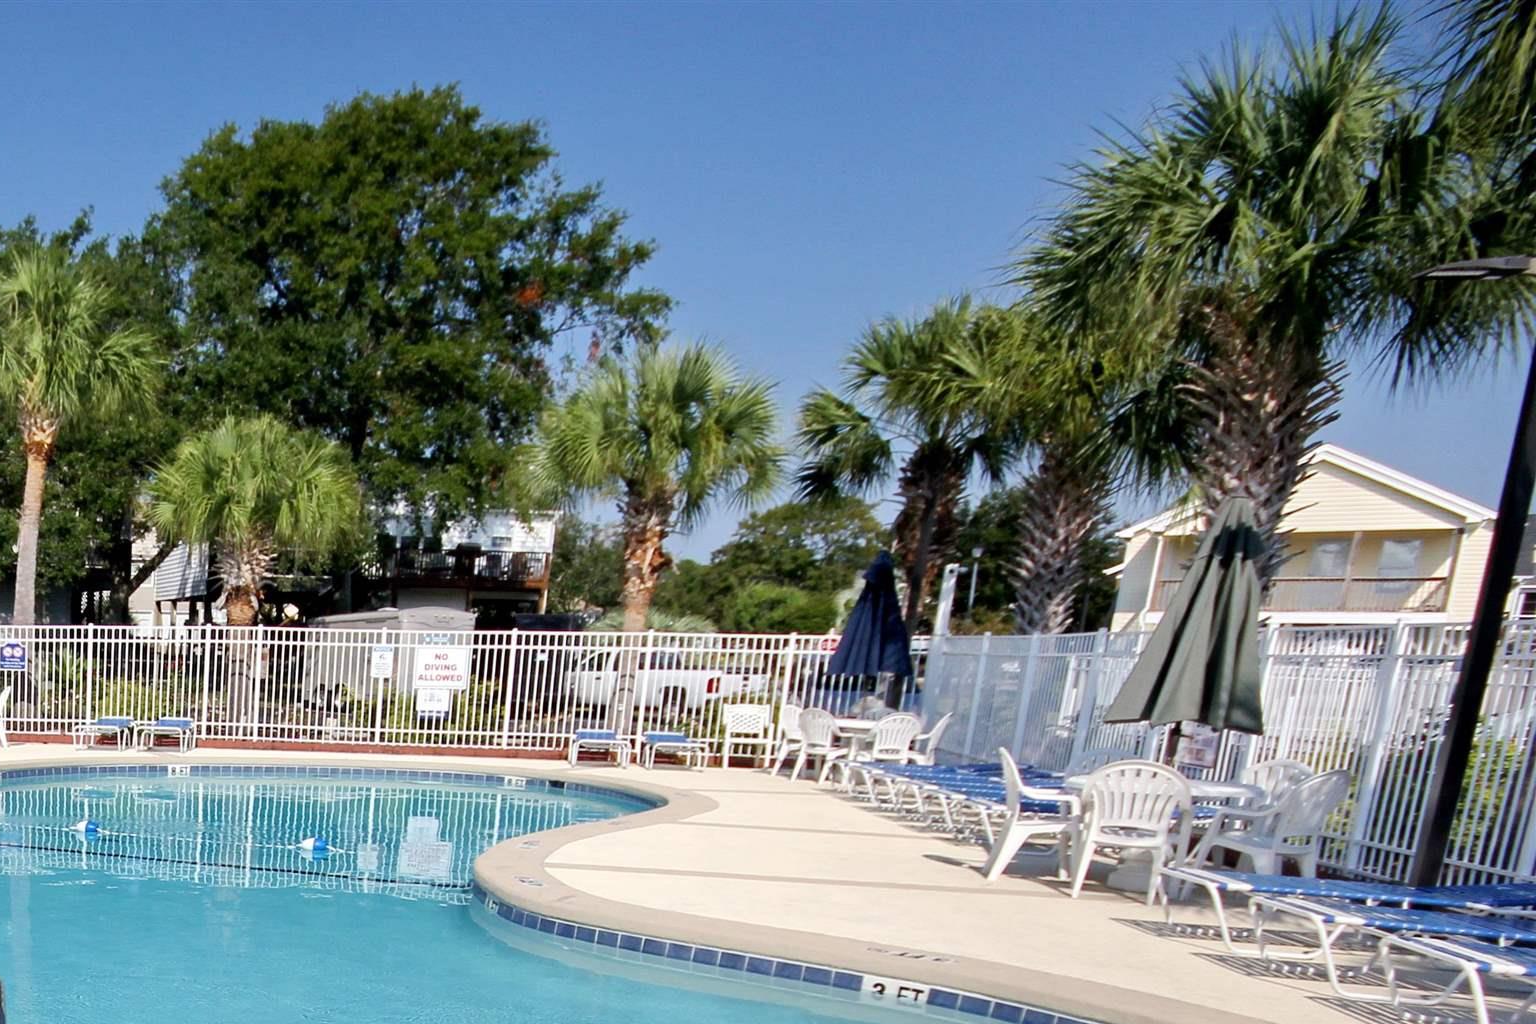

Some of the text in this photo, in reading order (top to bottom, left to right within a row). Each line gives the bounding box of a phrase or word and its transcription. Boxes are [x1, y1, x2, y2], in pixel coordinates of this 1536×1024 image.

[434, 653, 449, 661] NO
[424, 663, 458, 671] DIVING
[417, 674, 463, 682] ALLOWED
[897, 986, 925, 1001] FT
